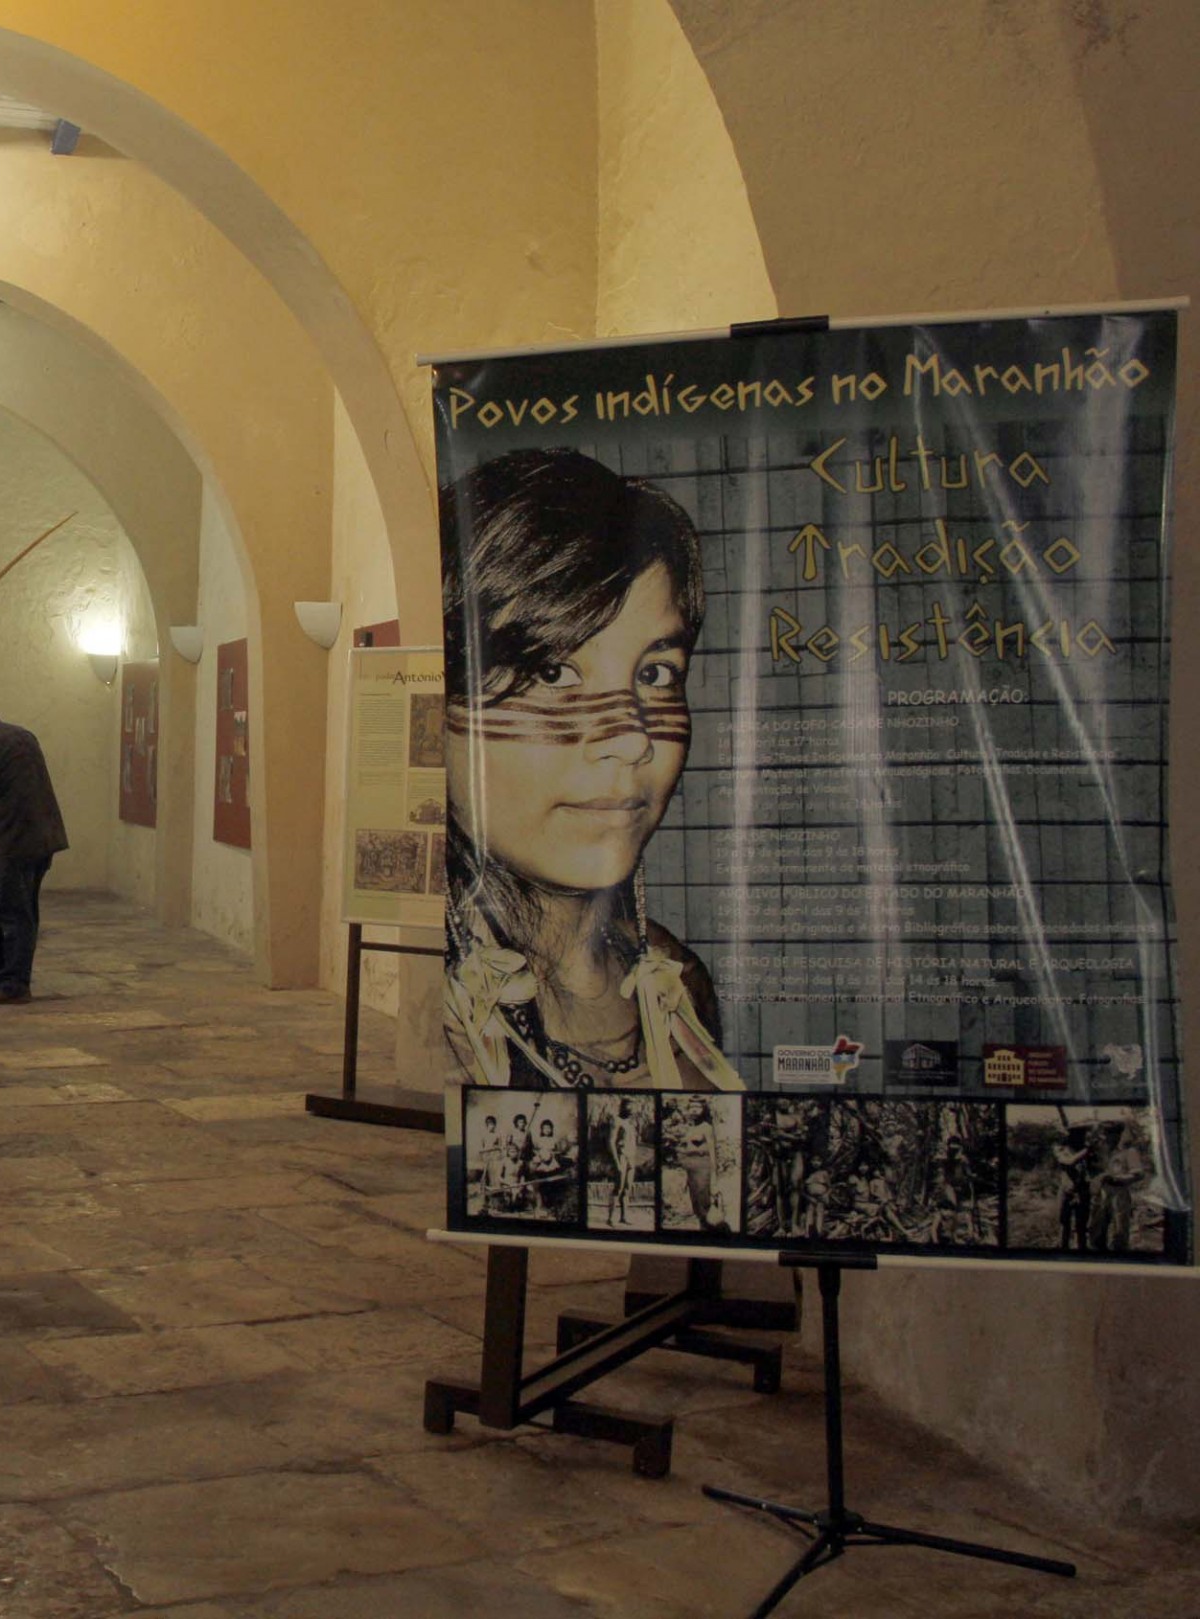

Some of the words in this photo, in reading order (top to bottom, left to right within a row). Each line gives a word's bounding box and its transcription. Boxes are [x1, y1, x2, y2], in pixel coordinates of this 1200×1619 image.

[450, 387, 579, 430] Povos
[832, 371, 888, 405] no
[904, 347, 1151, 397] Maranhão
[810, 434, 1052, 494] Cultura
[788, 519, 1081, 584] Tradição
[769, 601, 1117, 664] Resistência
[888, 685, 1029, 706] PROGRAMAÇÃO:
[923, 887, 943, 899] DO
[960, 958, 1025, 971] NATURAL
[777, 1056, 831, 1072] MARANHÃO
